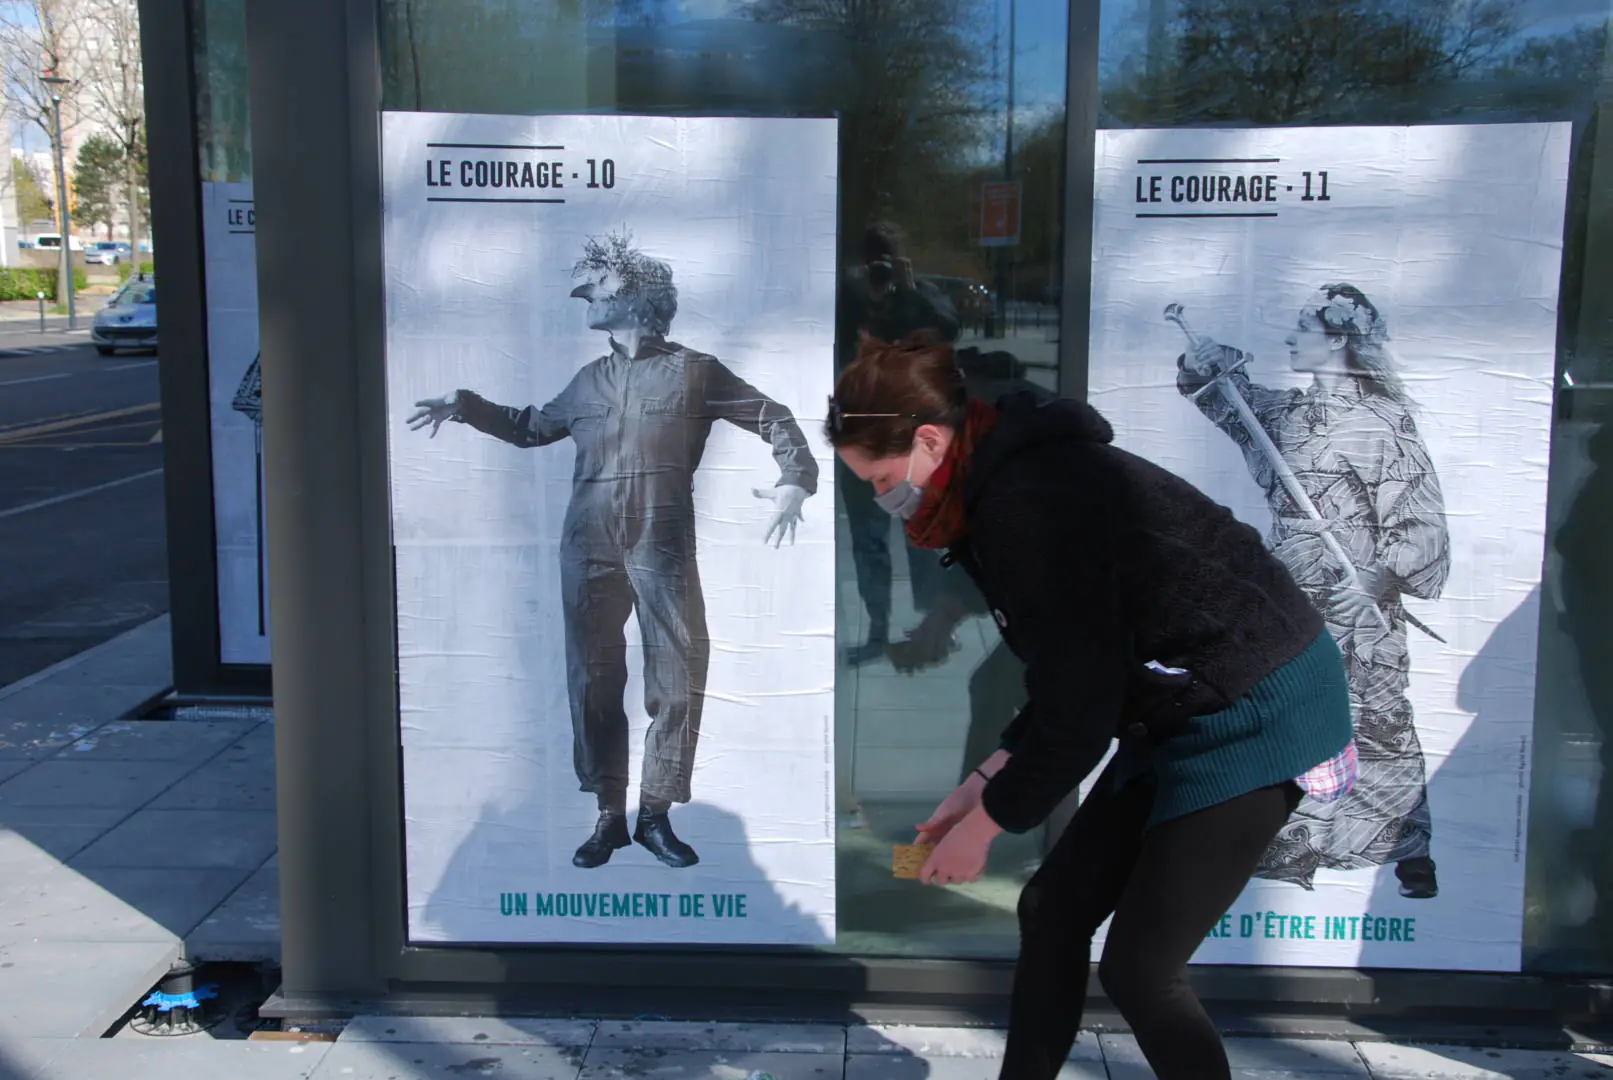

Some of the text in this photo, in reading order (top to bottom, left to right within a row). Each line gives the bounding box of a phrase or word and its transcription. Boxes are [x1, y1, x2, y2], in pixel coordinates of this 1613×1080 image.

[427, 160, 452, 187] LE
[460, 160, 563, 188] COURAGE
[586, 159, 615, 189] 10
[1136, 176, 1162, 203] LE
[1171, 175, 1277, 203] COURAGE
[1301, 171, 1331, 201] 11
[228, 209, 243, 225] LE
[500, 893, 747, 917] UN MOUVEMENT DE VIE
[1240, 910, 1316, 940] D'ÊTRE
[1324, 912, 1416, 942] INTÈGRE
